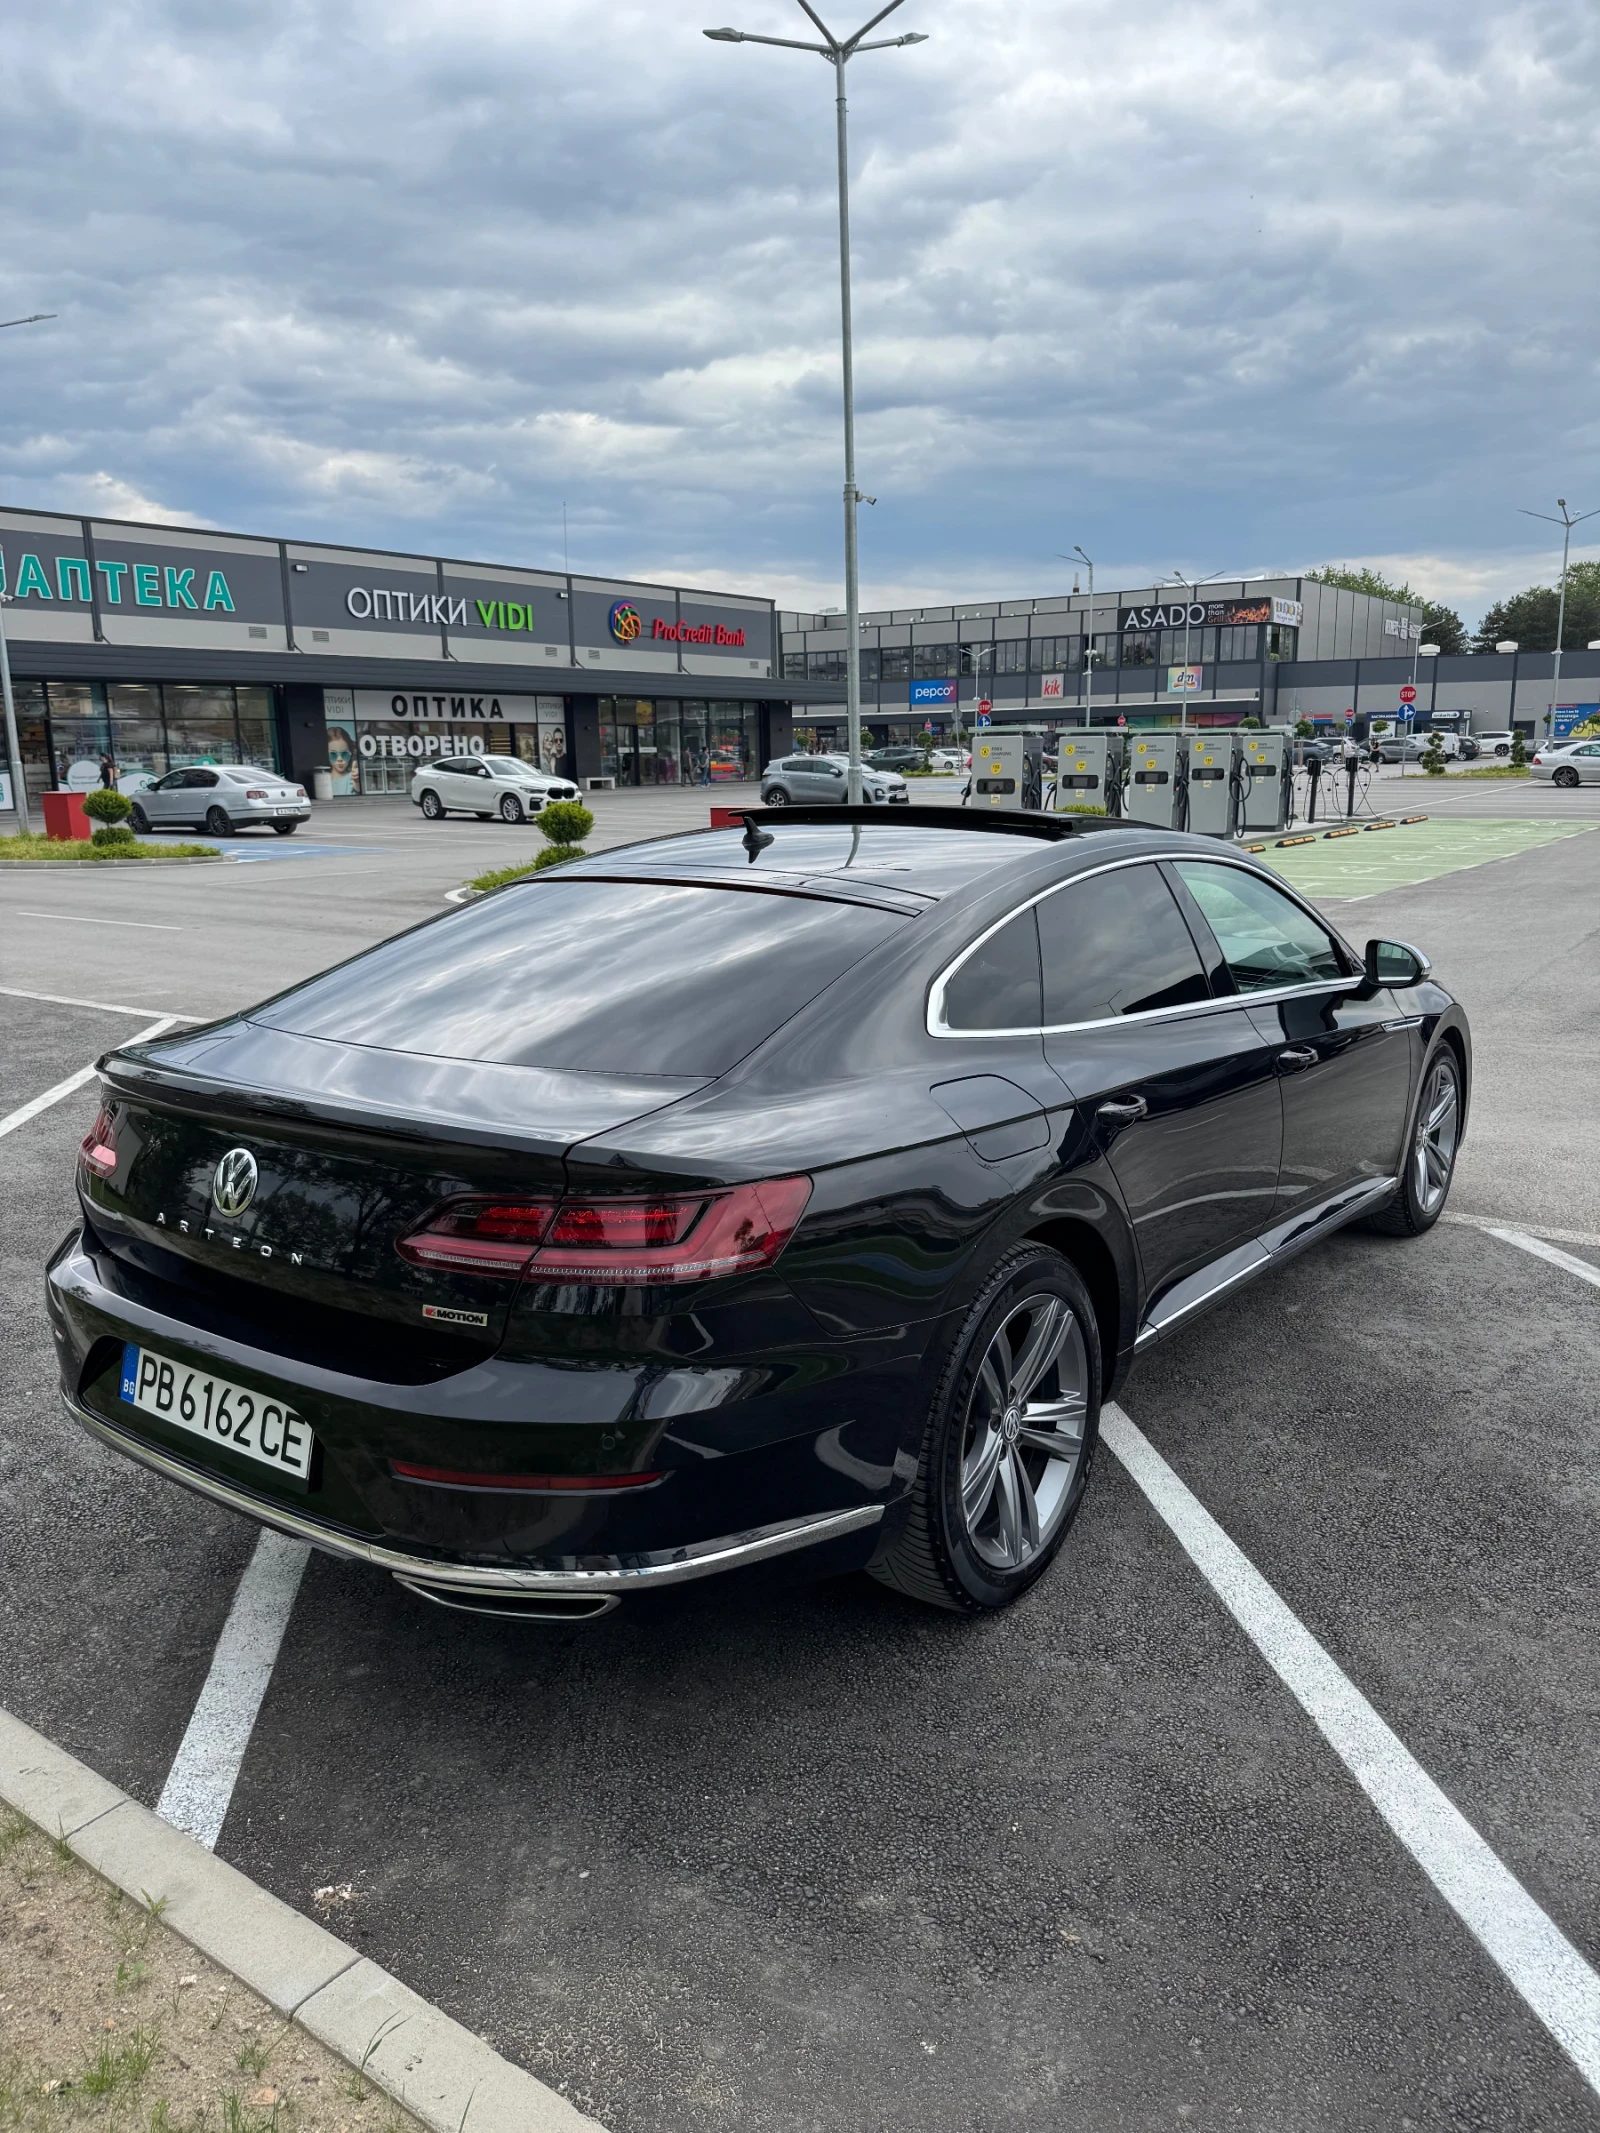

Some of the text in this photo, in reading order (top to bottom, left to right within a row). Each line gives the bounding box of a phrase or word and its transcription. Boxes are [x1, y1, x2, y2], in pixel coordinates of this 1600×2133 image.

[15, 554, 236, 612] АПТЕКА
[347, 587, 534, 632] ОПТИКИ VIDI
[1124, 603, 1206, 629] ASADO
[652, 618, 747, 647] ProCredit Bank
[1043, 677, 1060, 695] kik
[1177, 672, 1195, 683] dm
[324, 696, 352, 704] ПТИКИ
[915, 686, 951, 699] pepco
[327, 705, 344, 714] VIDI
[391, 694, 504, 719] ОПТИКА
[359, 734, 485, 757] ОТВОРЕНО
[156, 1212, 303, 1265] ARTEON
[123, 1378, 135, 1395] BG
